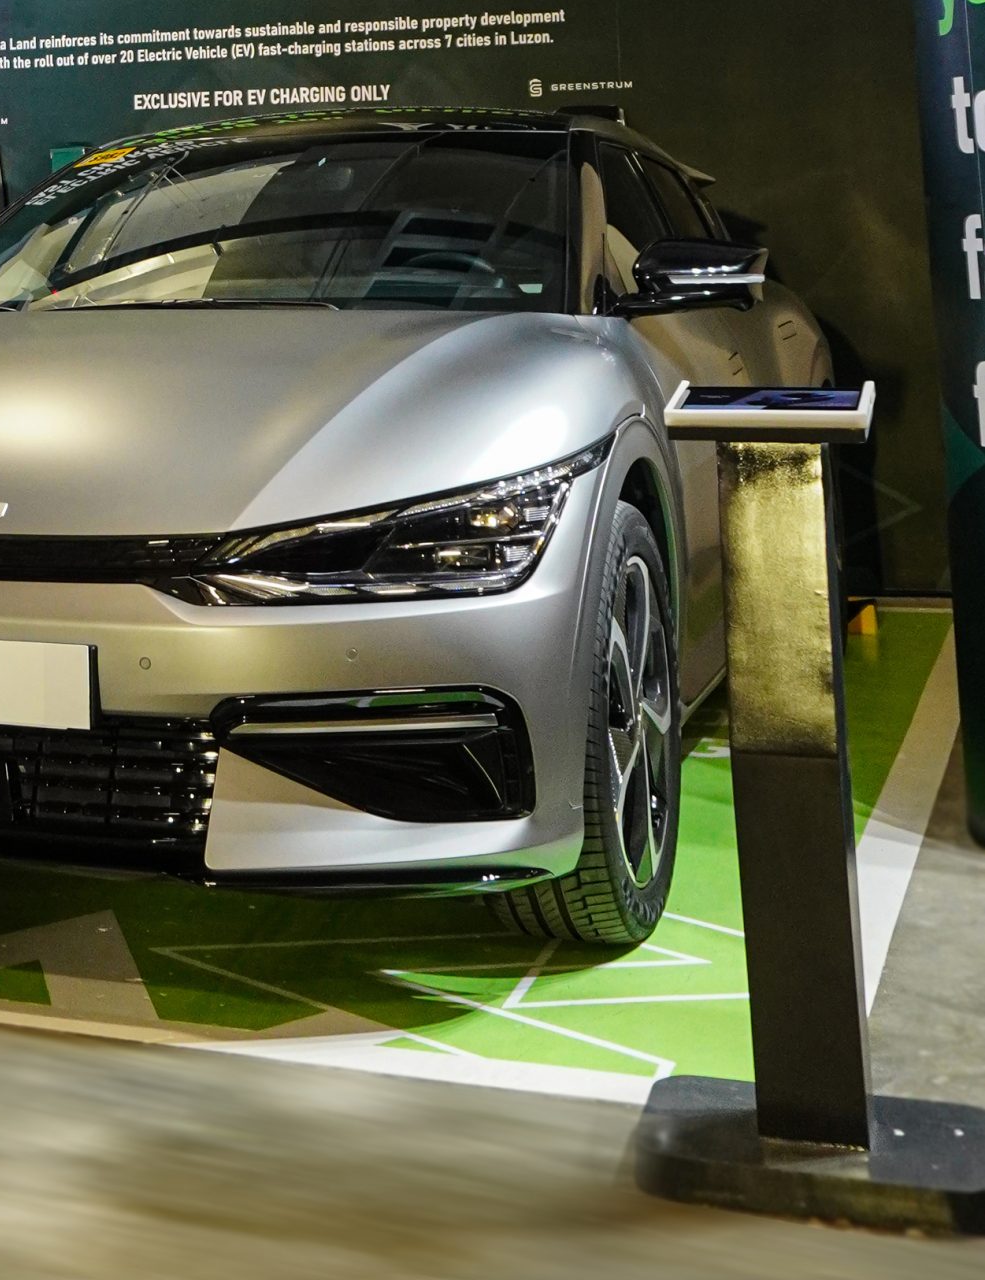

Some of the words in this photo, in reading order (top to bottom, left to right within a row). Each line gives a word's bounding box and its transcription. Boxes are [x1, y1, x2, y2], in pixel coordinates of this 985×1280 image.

[9, 36, 37, 51] Land
[39, 34, 97, 49] reinforces
[99, 32, 114, 46] its
[117, 28, 190, 45] commitment
[193, 24, 242, 40] towards
[245, 21, 315, 38] sustainable
[318, 20, 341, 35] and
[344, 16, 418, 34] responsible
[422, 14, 477, 32] property
[480, 9, 565, 26] development
[13, 55, 31, 69] the
[34, 54, 54, 68] roll
[56, 53, 74, 67] out
[77, 52, 89, 65] of
[91, 53, 117, 65] over
[120, 49, 134, 63] 20
[137, 47, 182, 62] Electric
[184, 45, 228, 60] Vehicle
[231, 43, 255, 60] (EV)
[258, 41, 341, 57] fast-charging
[344, 38, 395, 52] stations
[399, 38, 441, 50] across
[444, 35, 452, 48] 7
[456, 32, 491, 47] cities
[495, 32, 507, 45] in
[511, 31, 554, 45] Luzon.
[134, 91, 210, 110] EXCLUSIVE
[214, 89, 243, 106] FOR
[247, 88, 266, 105] EV
[270, 86, 346, 104] CHARGING
[350, 84, 390, 102] ONLY
[551, 81, 633, 91] GREENSTRUM
